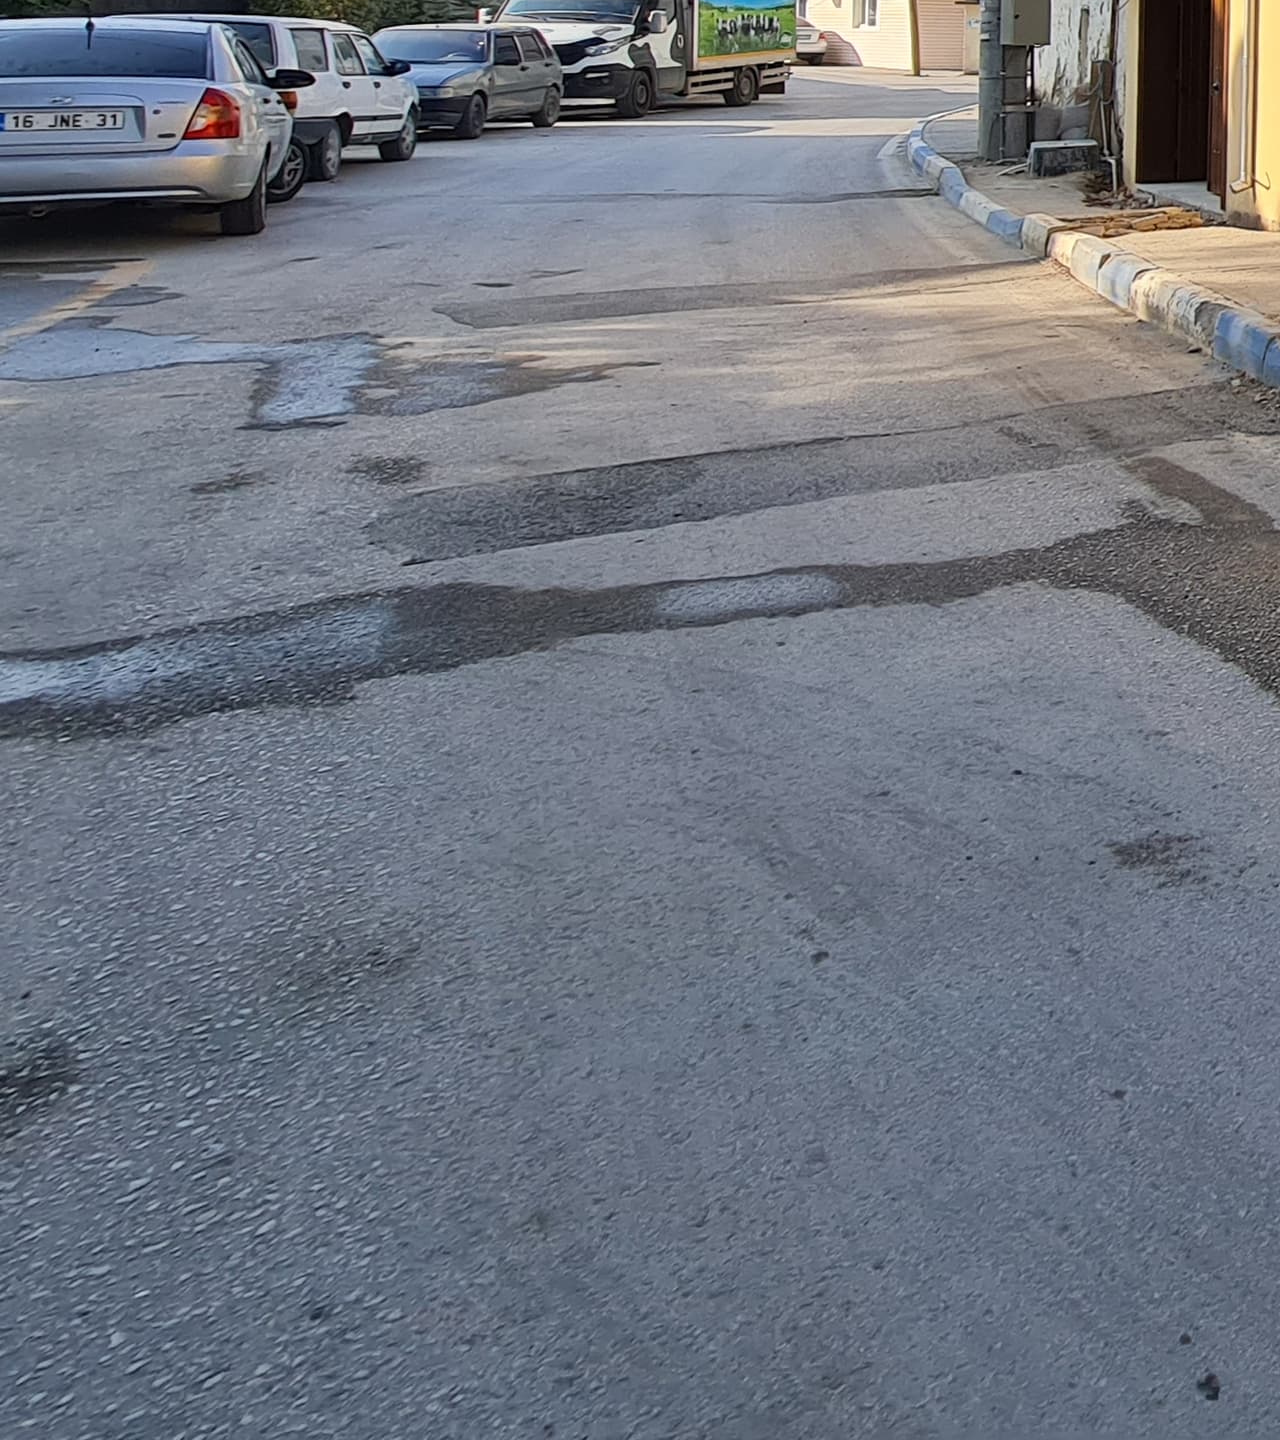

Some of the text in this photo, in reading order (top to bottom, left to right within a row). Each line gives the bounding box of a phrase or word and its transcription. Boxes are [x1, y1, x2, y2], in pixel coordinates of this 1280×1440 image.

[12, 113, 117, 128] 16 JNE 31
